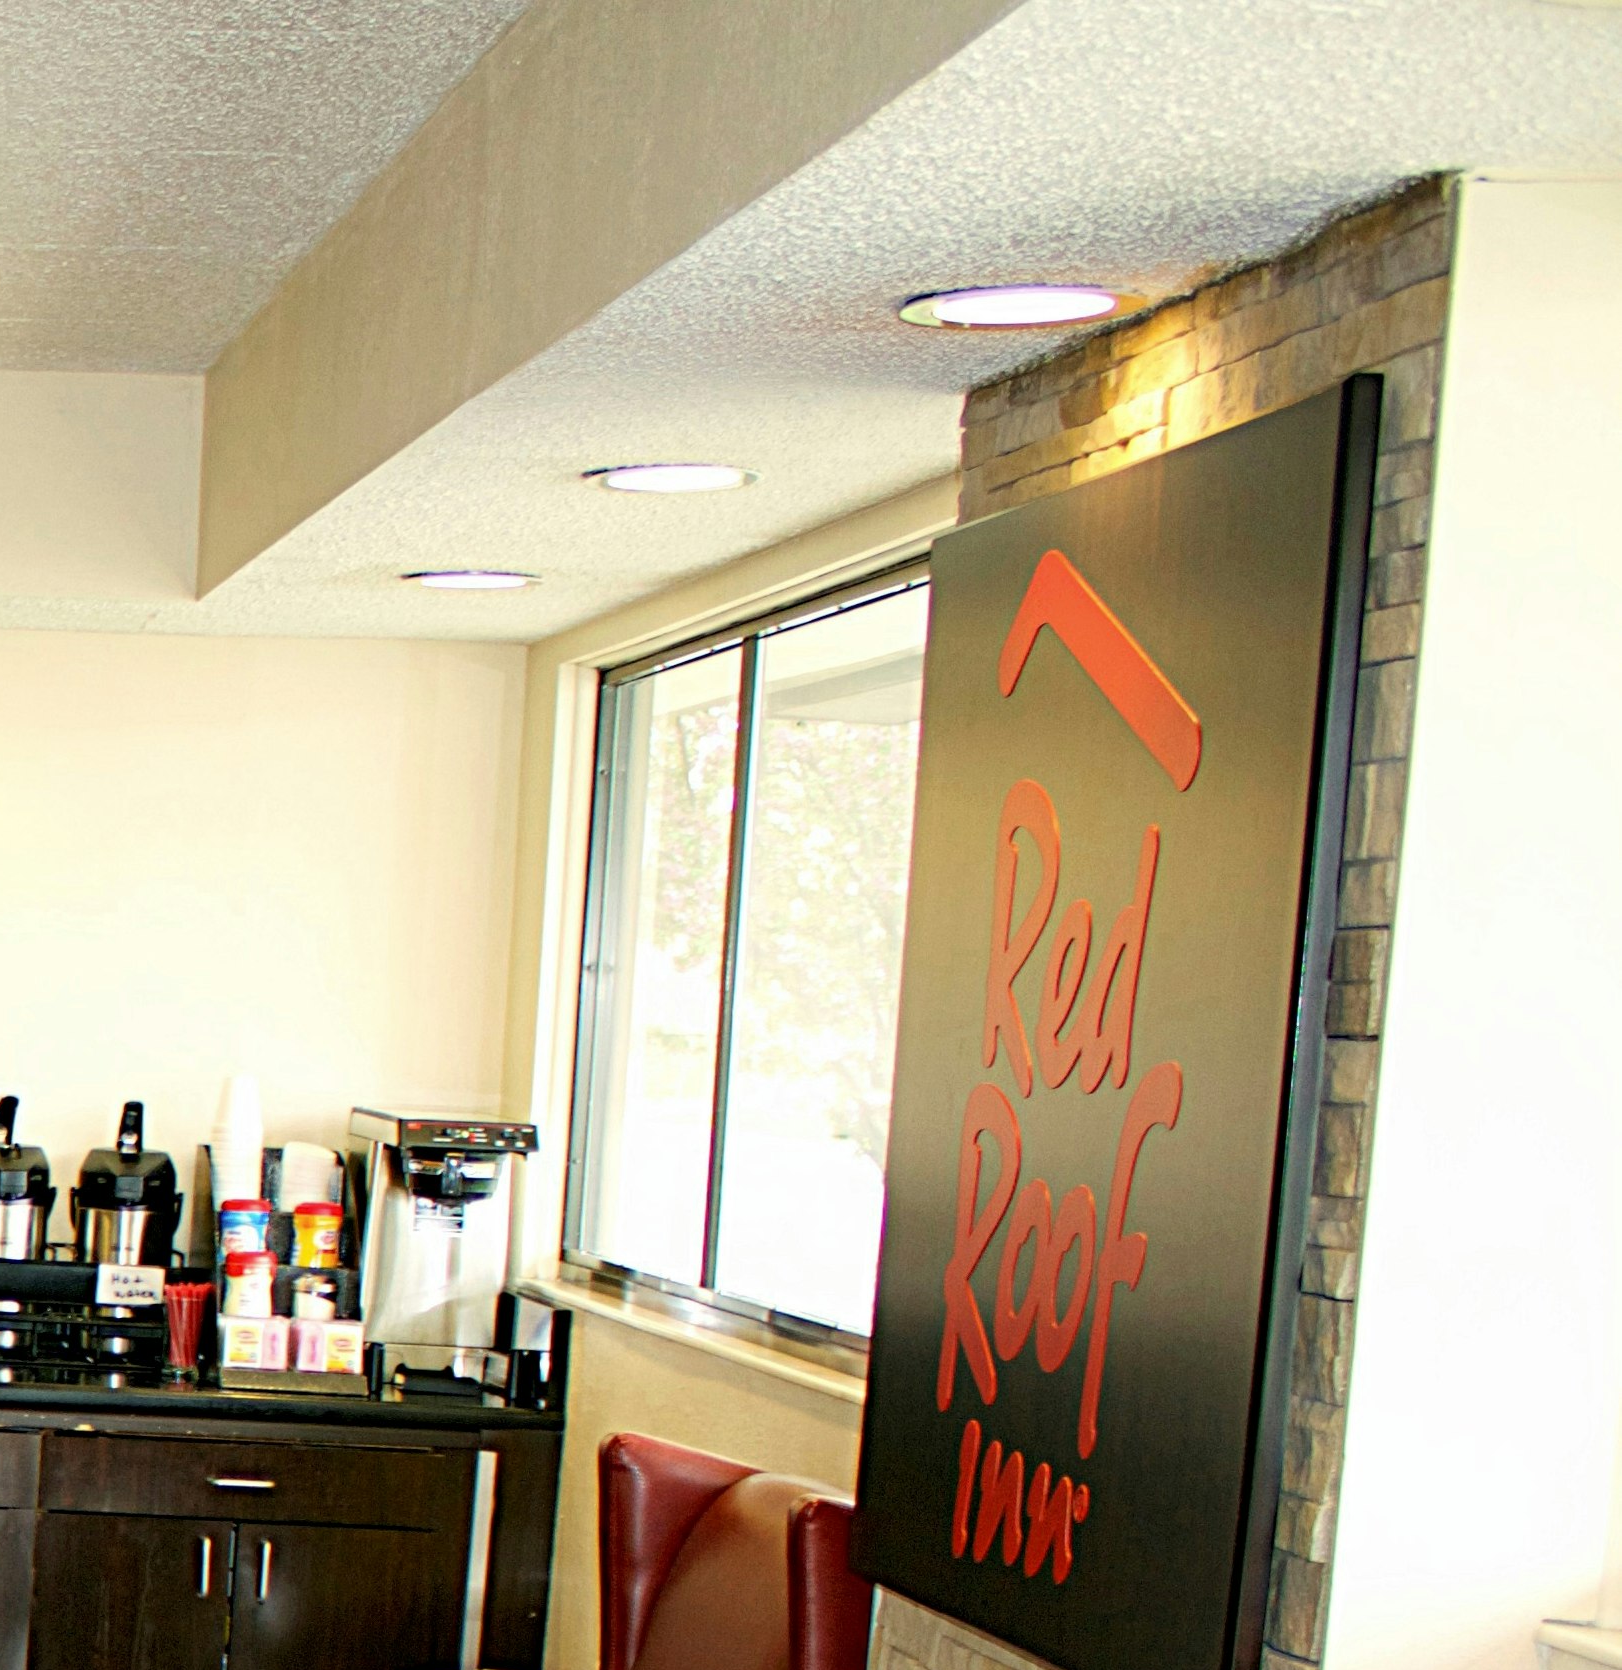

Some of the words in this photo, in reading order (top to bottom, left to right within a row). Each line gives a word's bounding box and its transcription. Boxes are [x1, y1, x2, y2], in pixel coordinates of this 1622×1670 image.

[982, 778, 1160, 1098] Red
[936, 1062, 1183, 1460] Roof
[952, 1419, 1074, 1585] Inn
